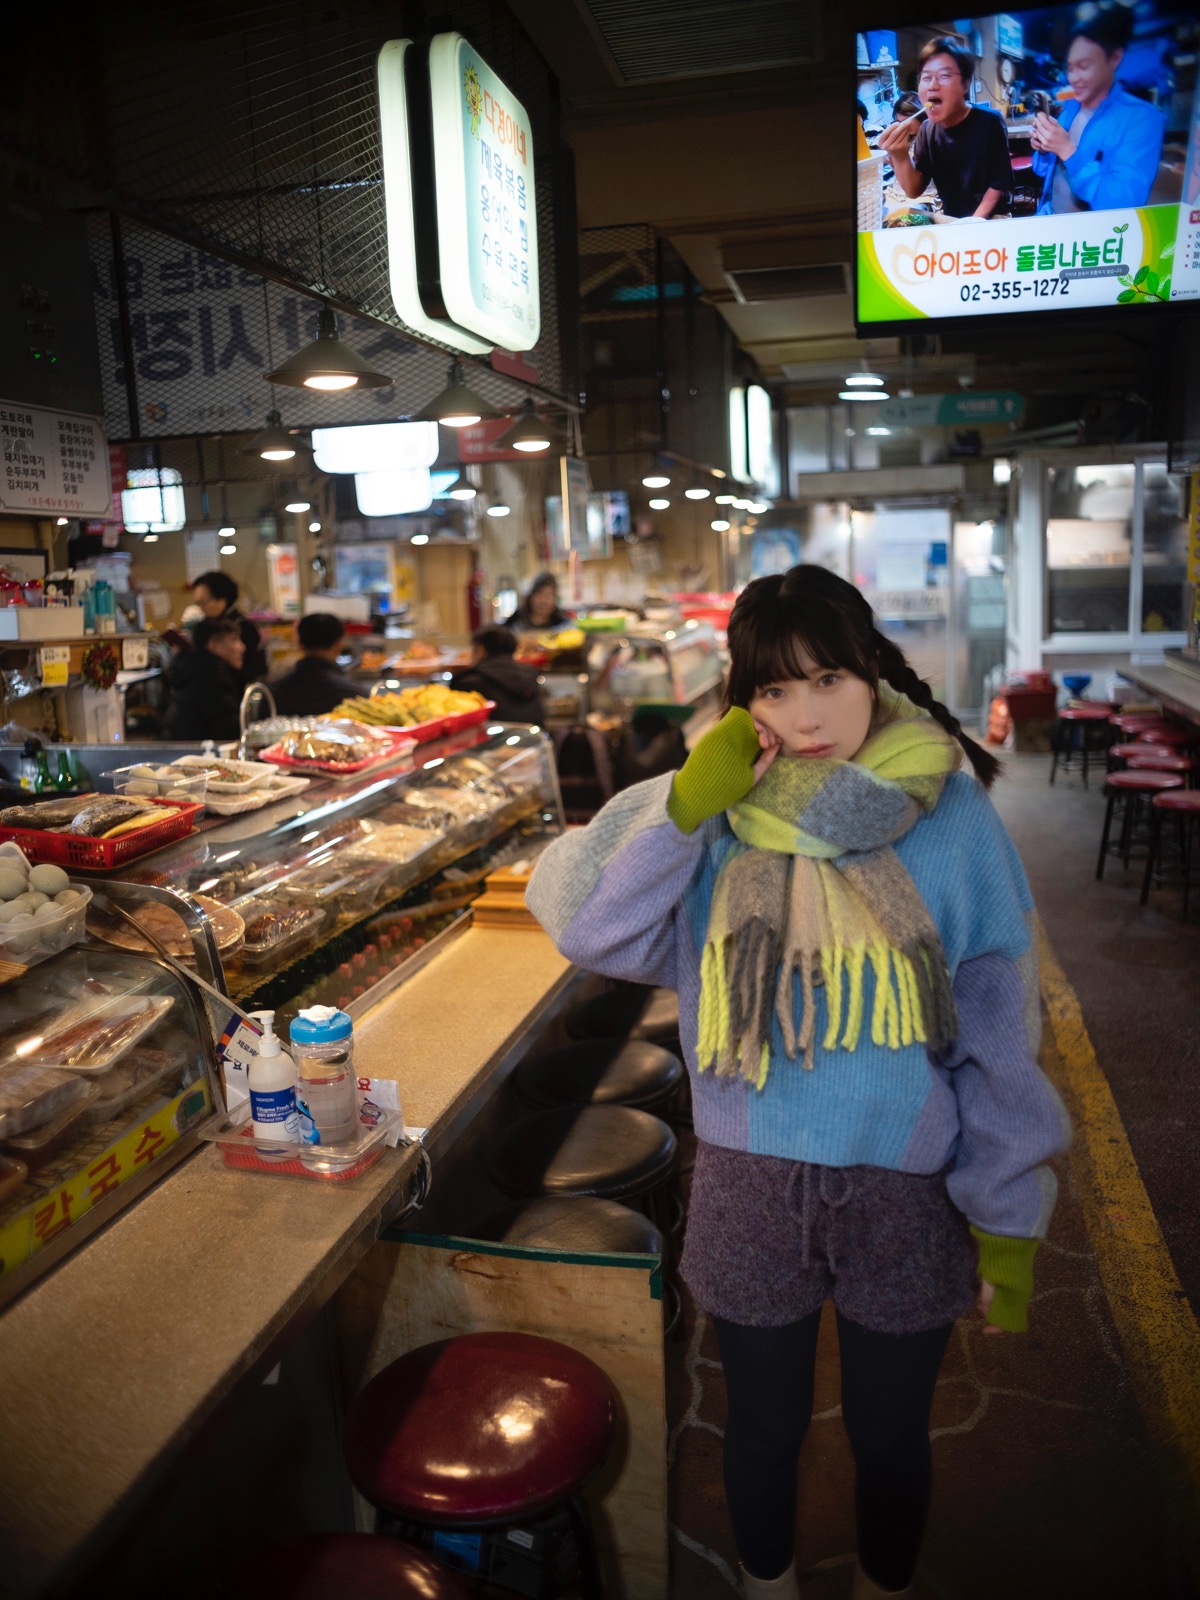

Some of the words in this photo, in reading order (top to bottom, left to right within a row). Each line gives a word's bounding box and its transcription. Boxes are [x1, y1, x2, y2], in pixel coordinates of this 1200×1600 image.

[483, 89, 527, 166] 다경이네
[481, 139, 526, 211] 제육볶음
[913, 247, 1009, 278] 아이조아
[1015, 236, 1124, 273] 돌봄나눔터
[960, 278, 1070, 301] 02-355-1272
[0, 411, 33, 426] 도토리묵
[1, 424, 34, 439] 계란말이
[4, 452, 45, 466] 돼지껍데기
[6, 466, 46, 479] 순두부찌개
[7, 479, 40, 492] 김치찌개
[35, 1125, 165, 1241] 칼국수
